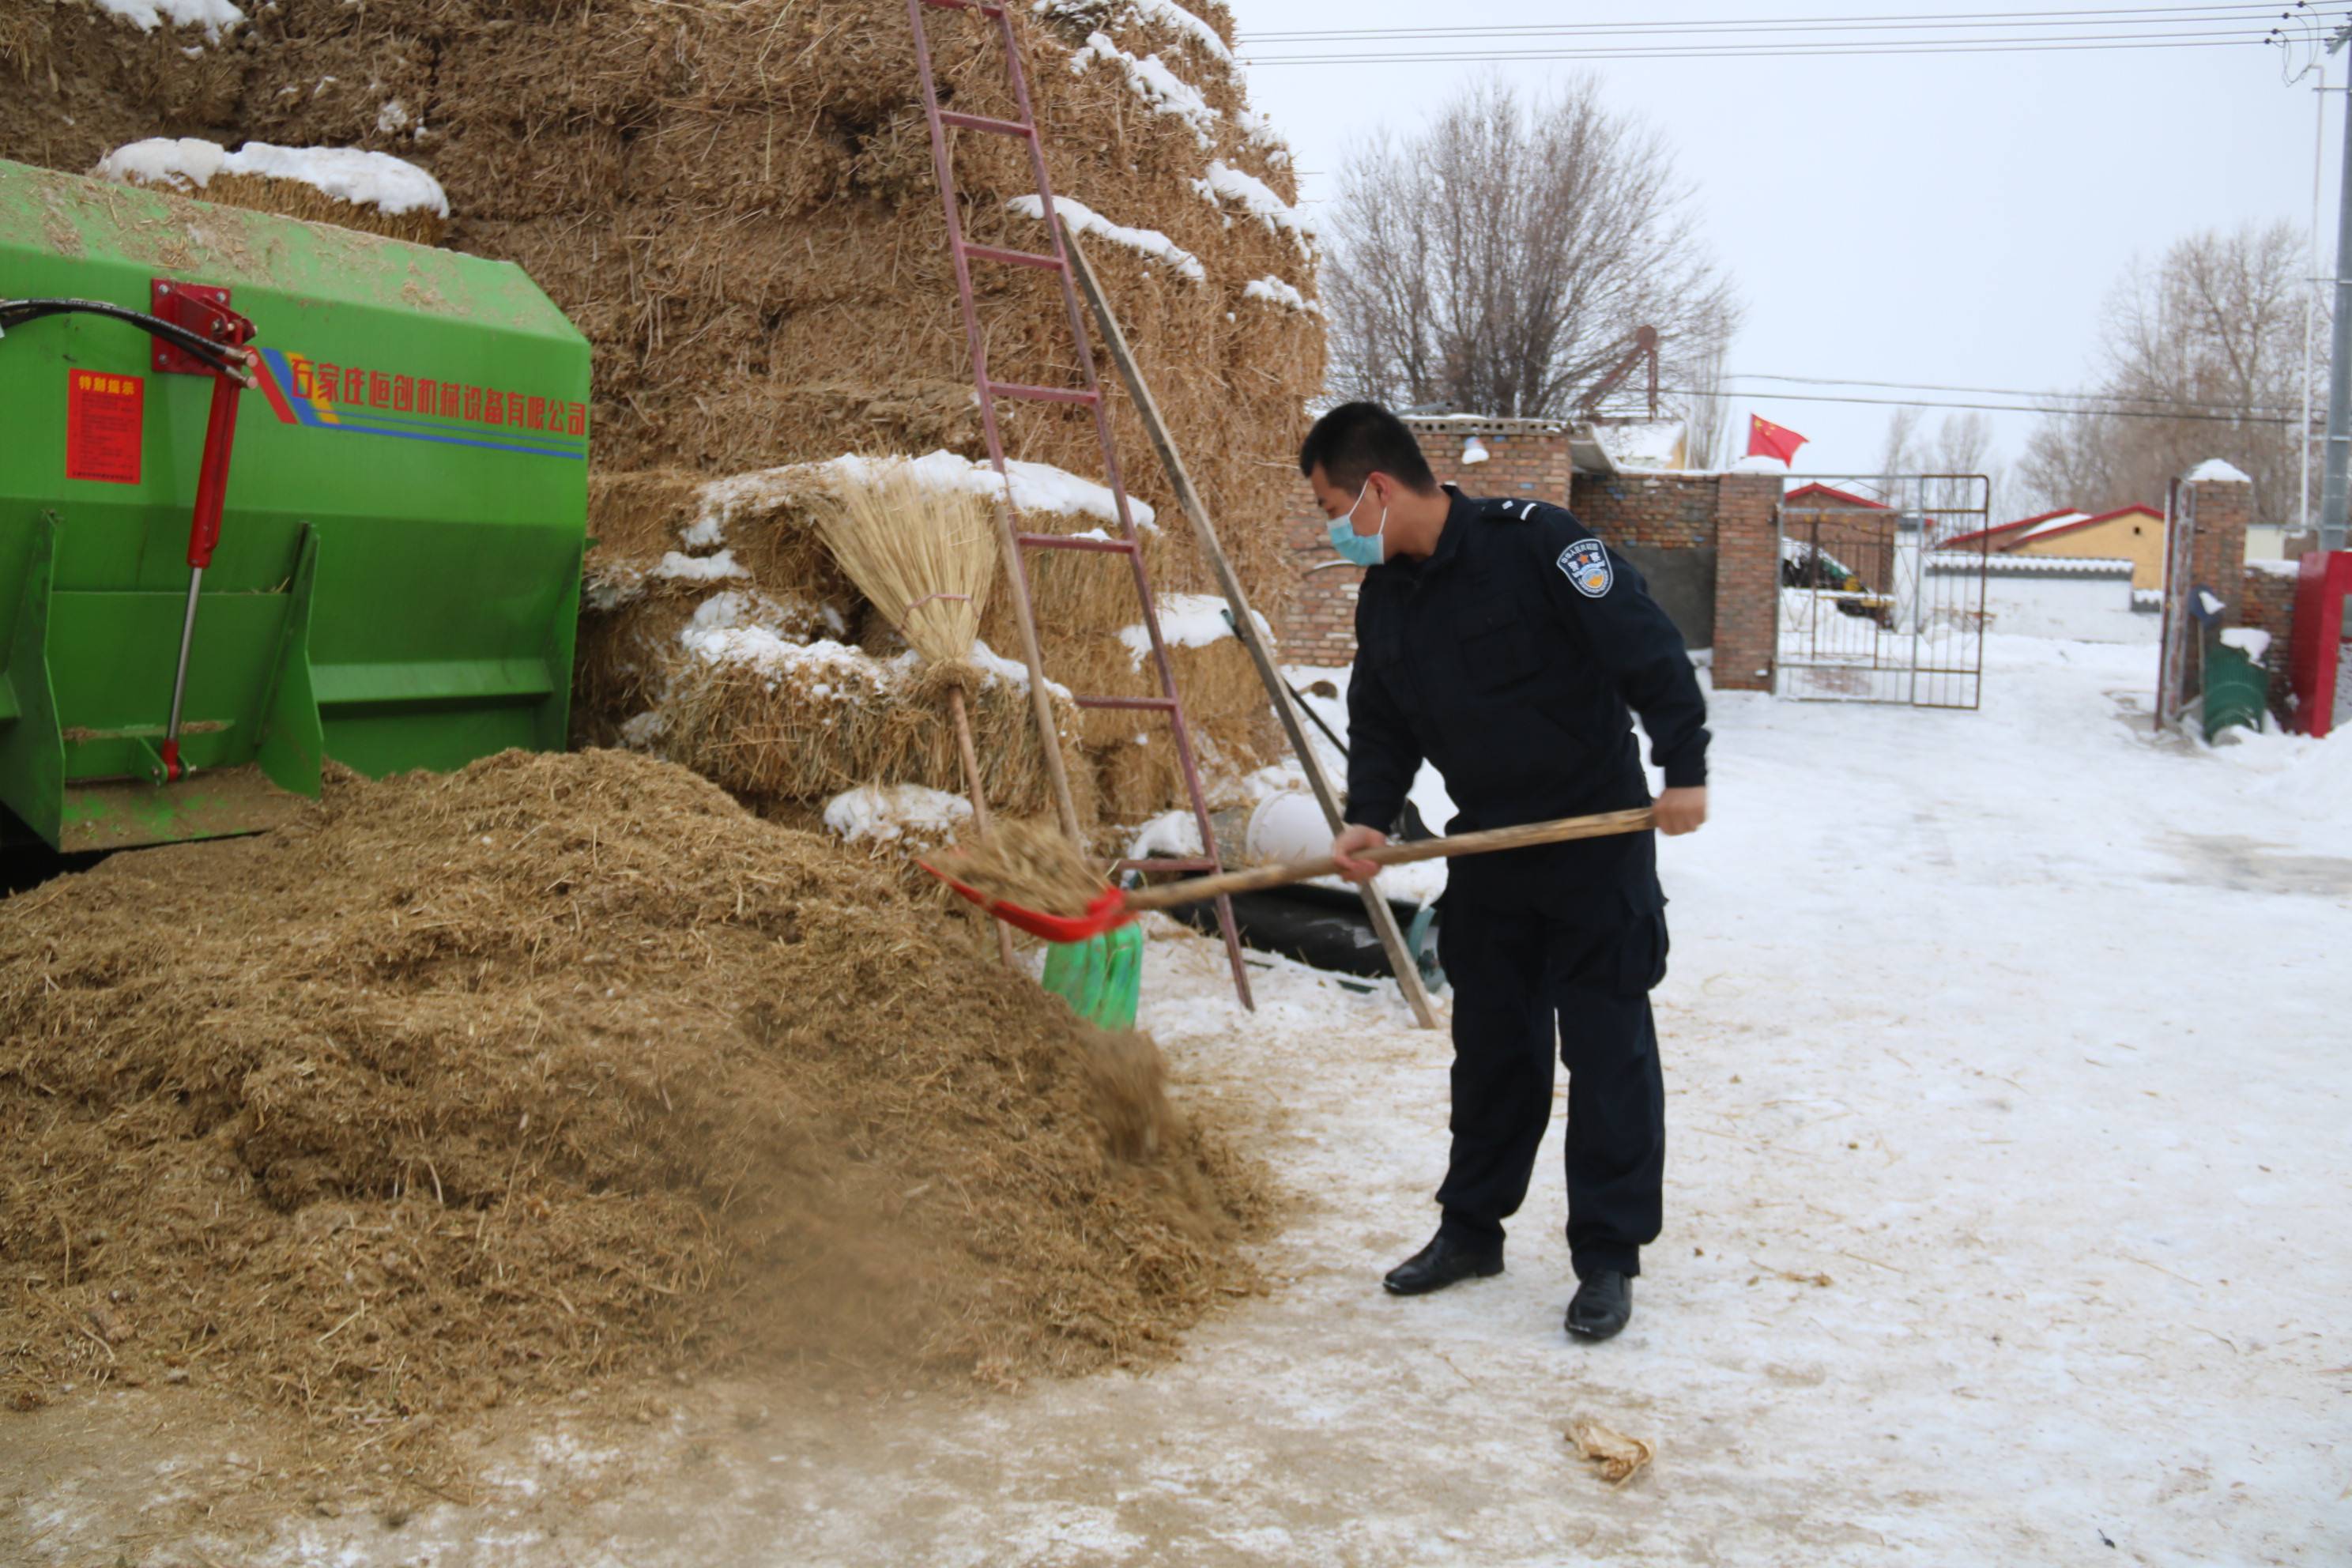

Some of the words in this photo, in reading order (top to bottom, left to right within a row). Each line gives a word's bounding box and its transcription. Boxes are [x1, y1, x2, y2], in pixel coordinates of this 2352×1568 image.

[292, 359, 585, 435] 石家庄恒创机械设备有限公司
